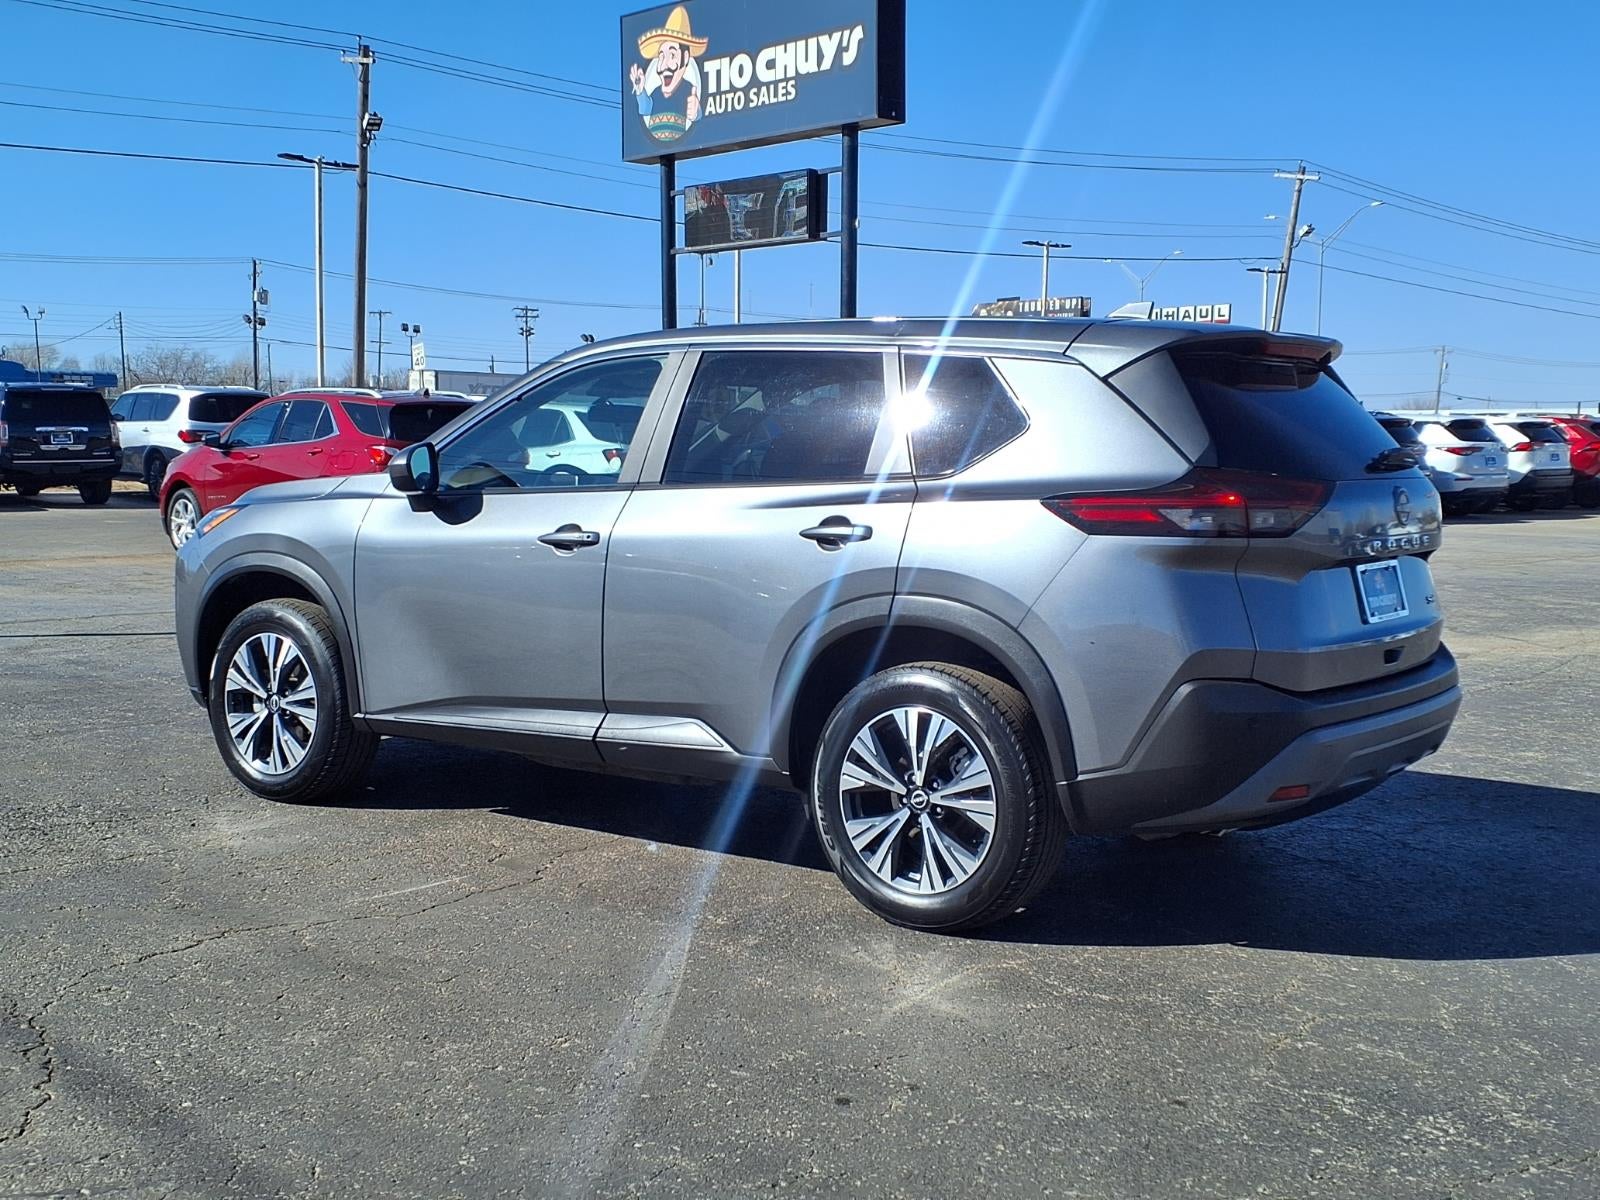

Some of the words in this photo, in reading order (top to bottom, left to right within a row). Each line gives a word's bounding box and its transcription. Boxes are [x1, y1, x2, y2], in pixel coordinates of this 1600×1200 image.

[703, 56, 753, 94] TIO
[755, 24, 864, 83] CHUY'S
[704, 90, 745, 117] AUTO
[749, 79, 797, 109] SALES
[414, 355, 425, 366] 40
[1373, 535, 1431, 552] ROGUE
